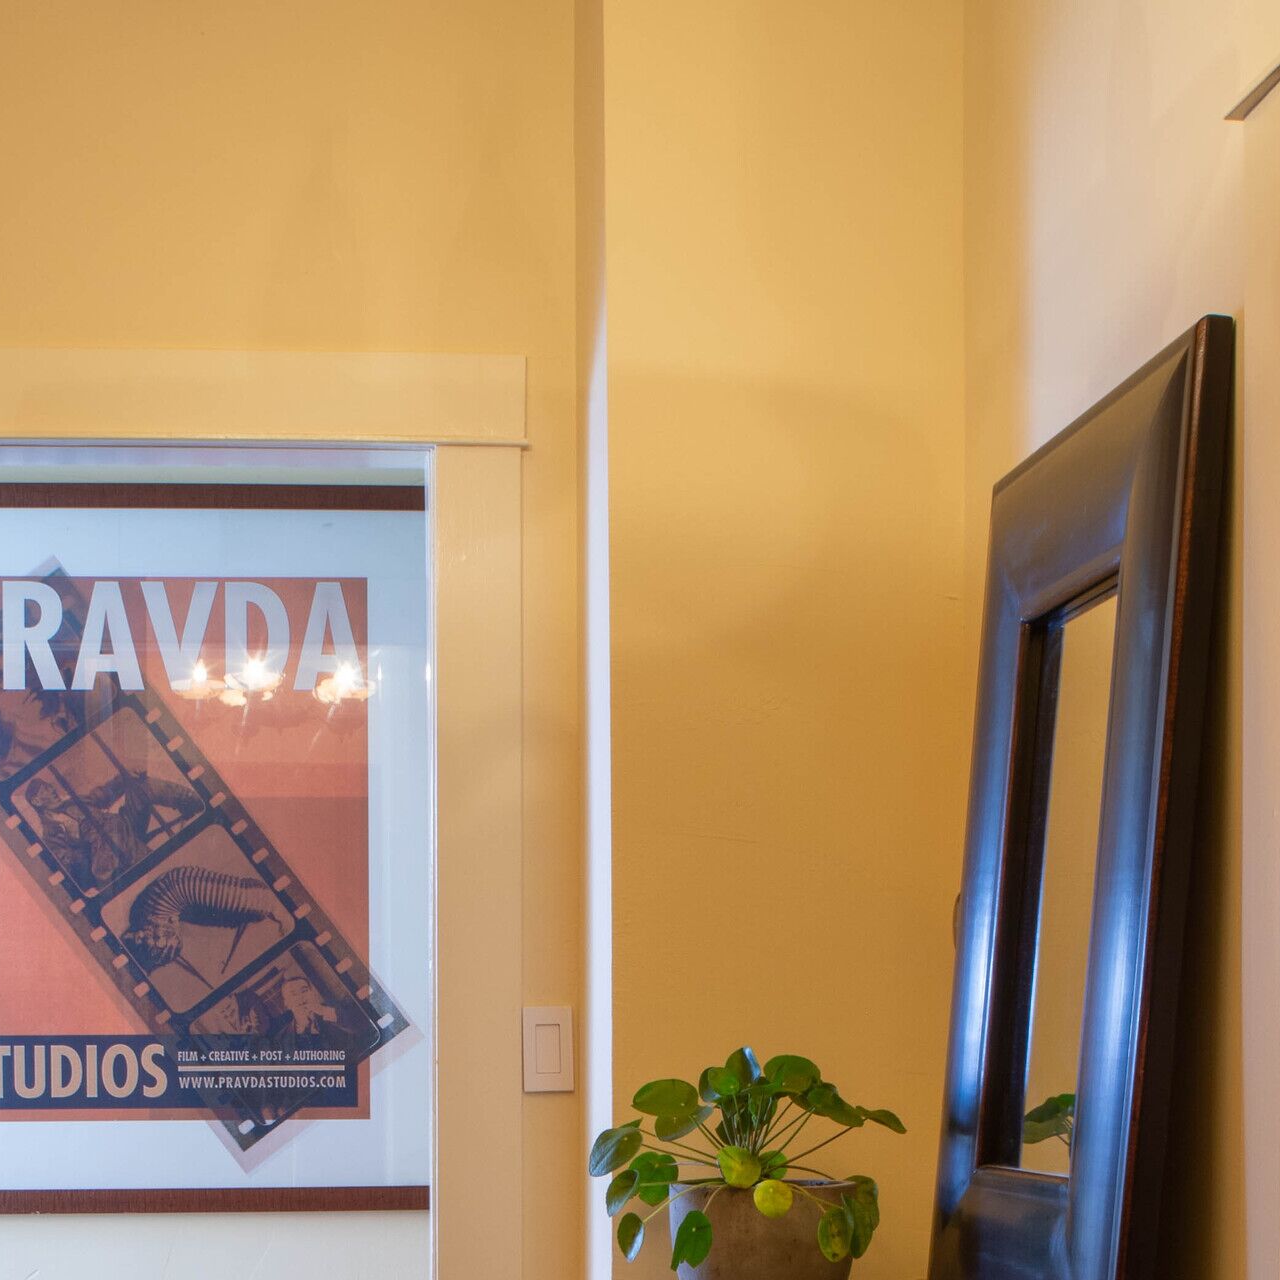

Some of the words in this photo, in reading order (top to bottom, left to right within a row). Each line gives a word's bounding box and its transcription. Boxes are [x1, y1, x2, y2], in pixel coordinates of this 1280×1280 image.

[177, 1051, 199, 1062] FILM
[208, 1051, 250, 1061] CREATIVE
[260, 1051, 283, 1061] POST
[292, 1050, 346, 1061] AUTHORING
[178, 1076, 347, 1089] WWW.PRAVDASTUDIOS.COM
